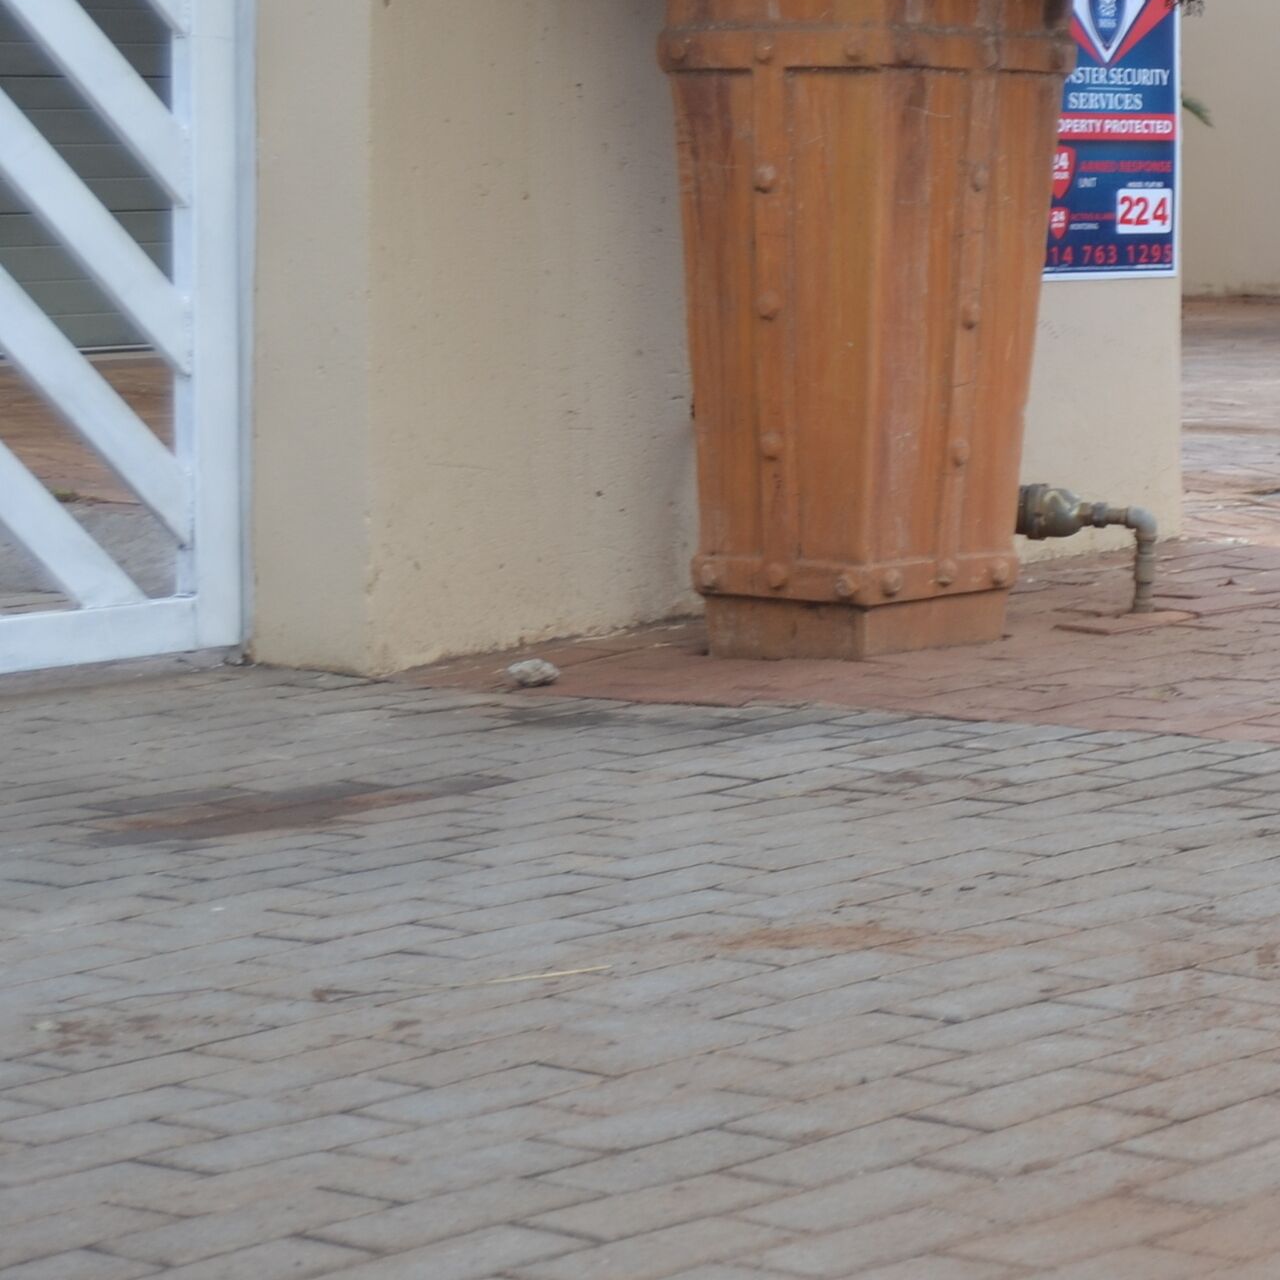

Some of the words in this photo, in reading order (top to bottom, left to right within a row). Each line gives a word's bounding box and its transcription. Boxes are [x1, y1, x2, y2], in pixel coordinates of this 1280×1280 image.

[1108, 68, 1170, 86] SECURITY
[1068, 92, 1143, 110] SERVICES
[1103, 119, 1173, 134] PROTECTED
[1119, 195, 1169, 226] 224
[1082, 244, 1118, 265] 763
[1127, 243, 1173, 263] 1295
